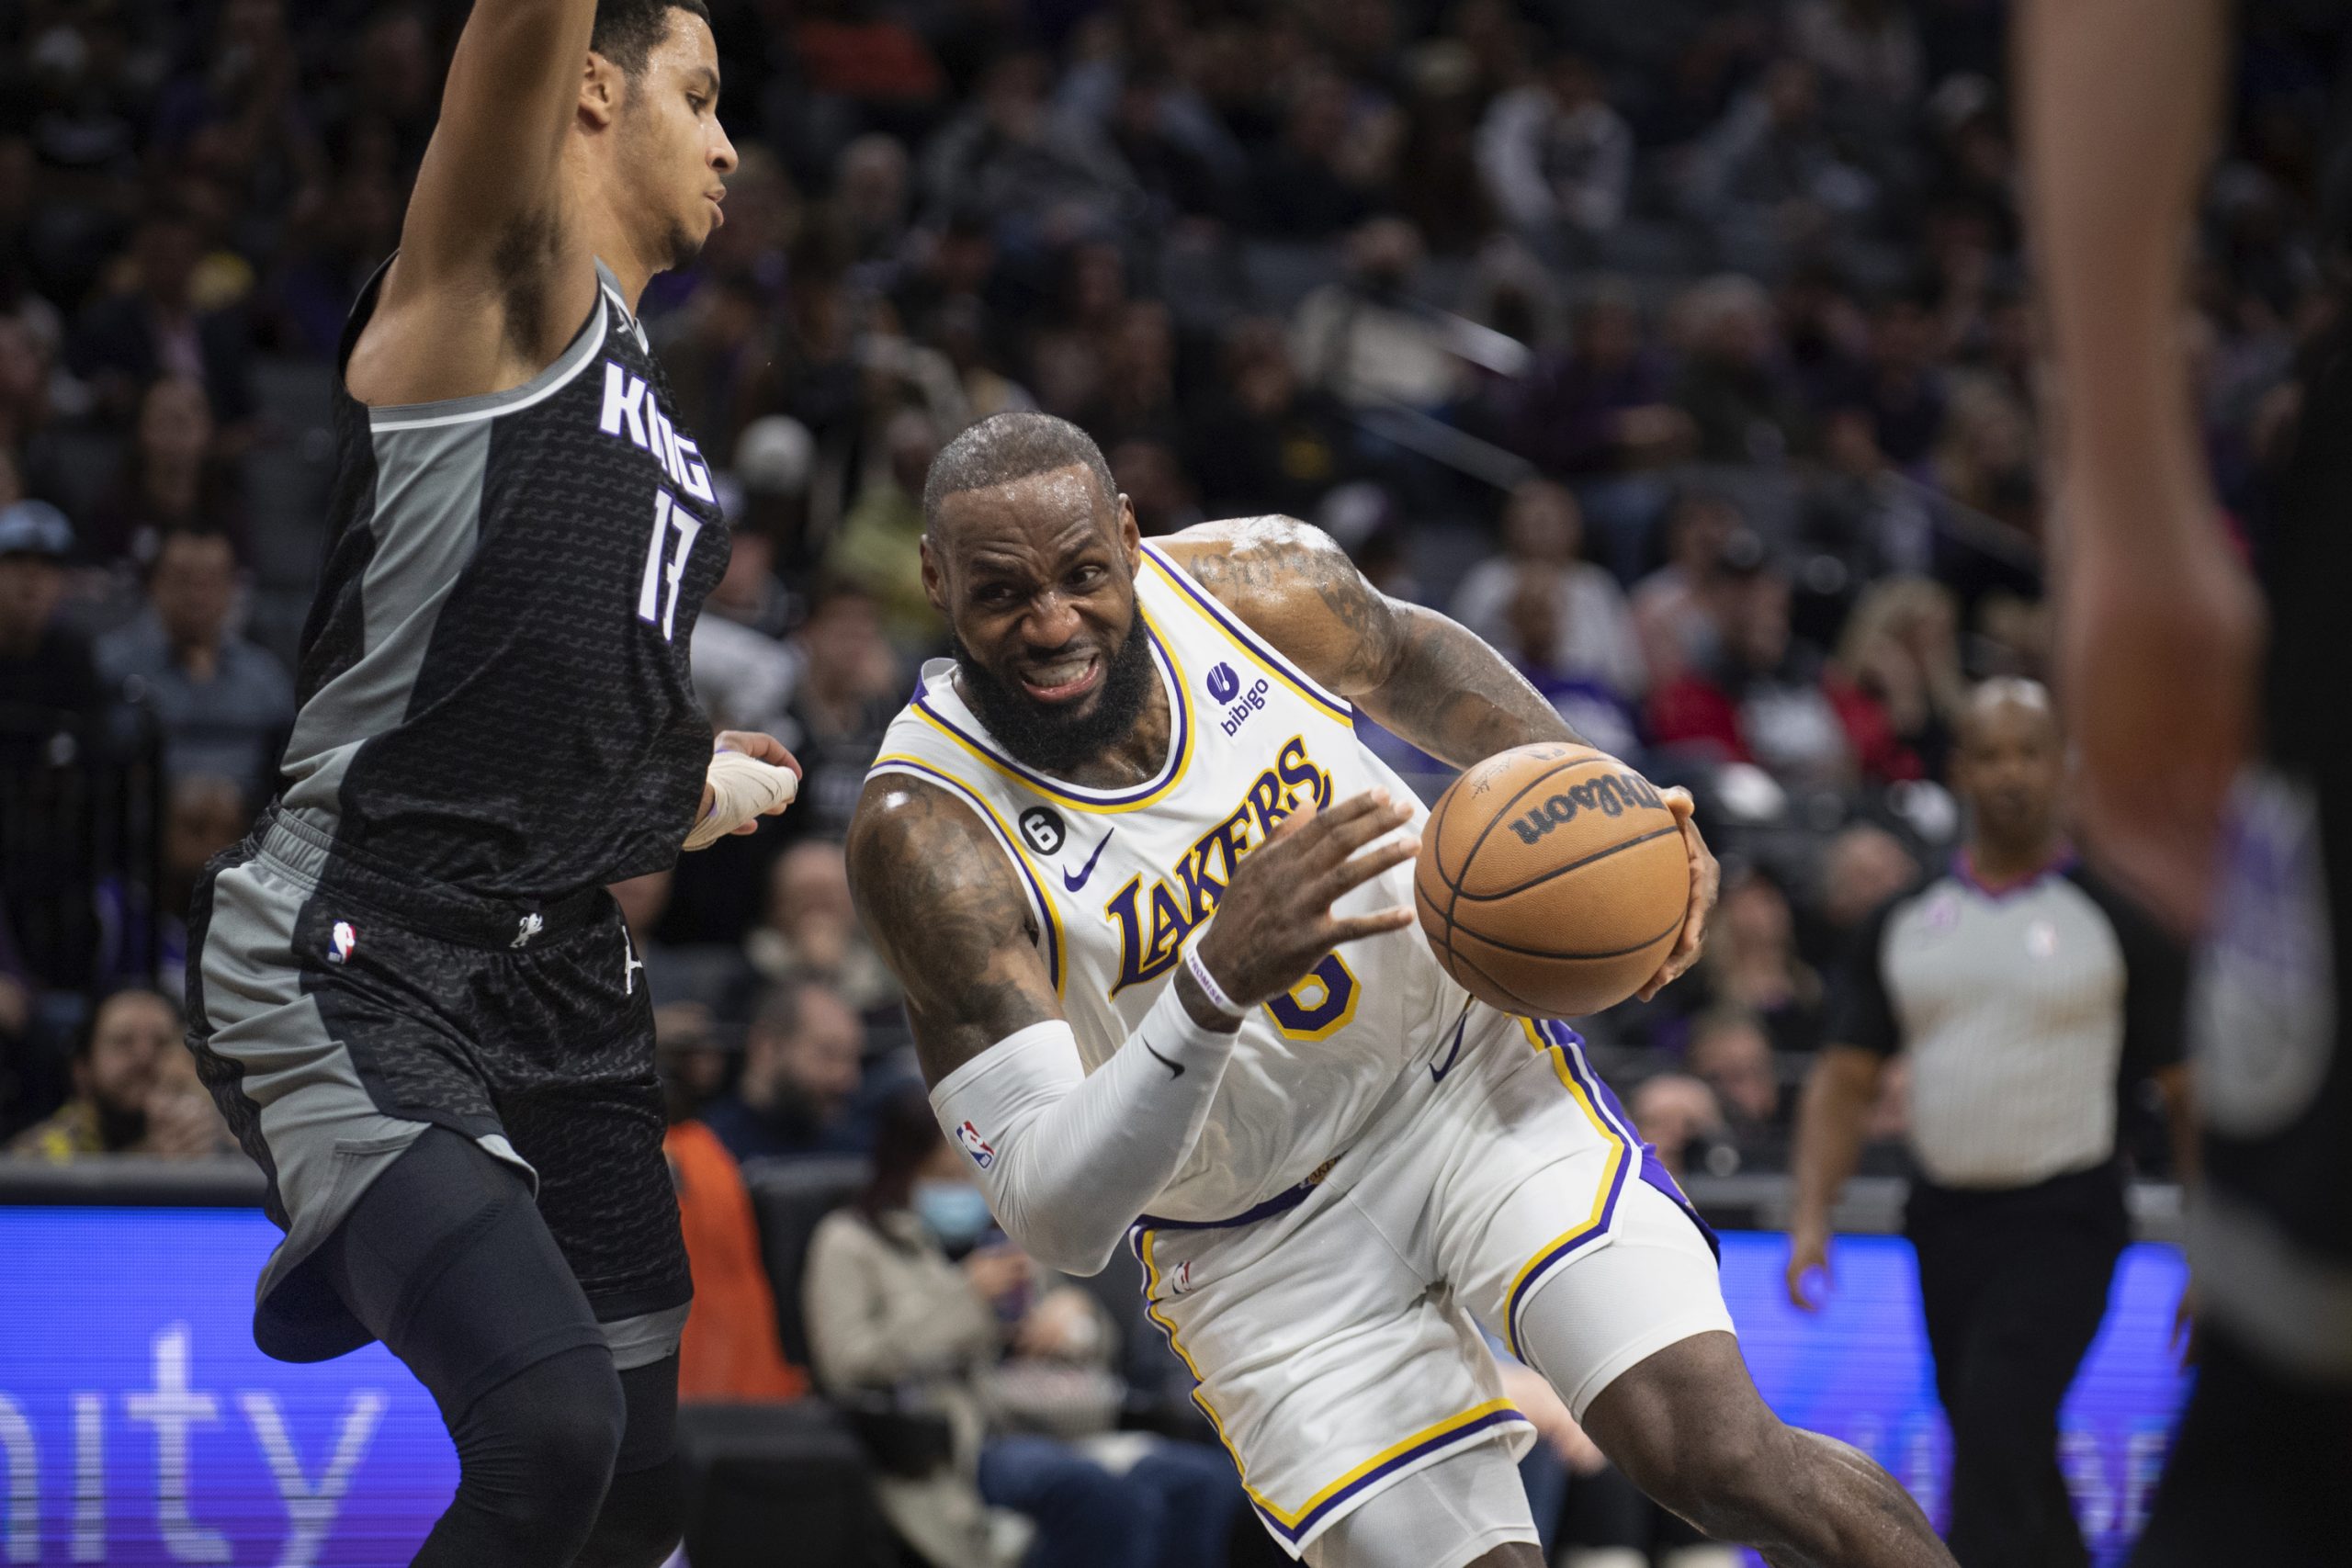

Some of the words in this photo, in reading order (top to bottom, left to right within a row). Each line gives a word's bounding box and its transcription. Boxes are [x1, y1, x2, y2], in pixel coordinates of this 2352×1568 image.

[599, 357, 717, 504] KING
[1220, 678, 1269, 737] bibigo
[1024, 814, 1058, 851] 6
[1508, 773, 1668, 845] Wilson
[1104, 734, 1334, 1003] LAKERS
